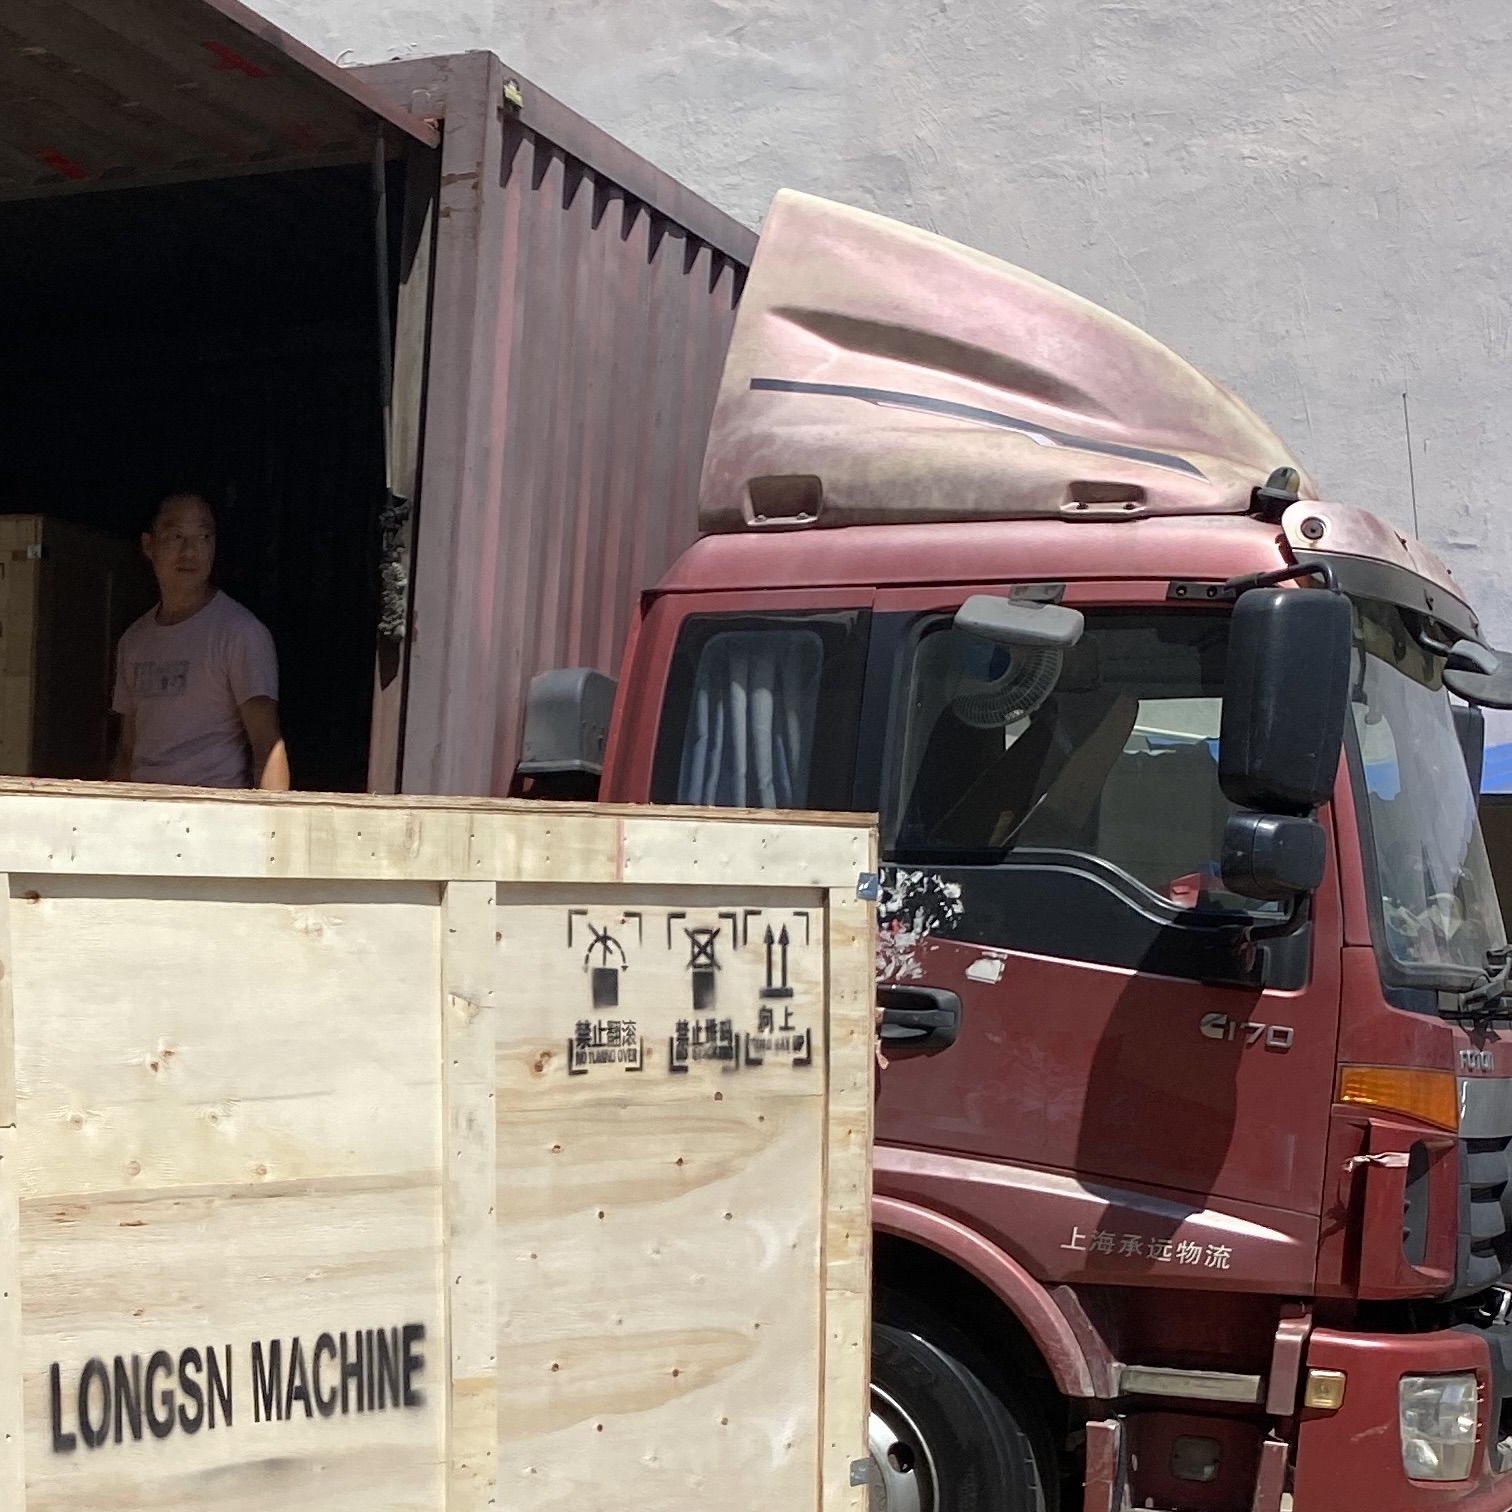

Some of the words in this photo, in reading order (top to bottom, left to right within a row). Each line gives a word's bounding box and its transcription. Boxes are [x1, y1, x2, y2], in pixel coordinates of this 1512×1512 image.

[758, 1004, 795, 1035] 向上
[1060, 1226, 1233, 1269] 上海承远物流
[49, 1344, 233, 1454] LONGSN
[251, 1323, 427, 1423] MACHINE
